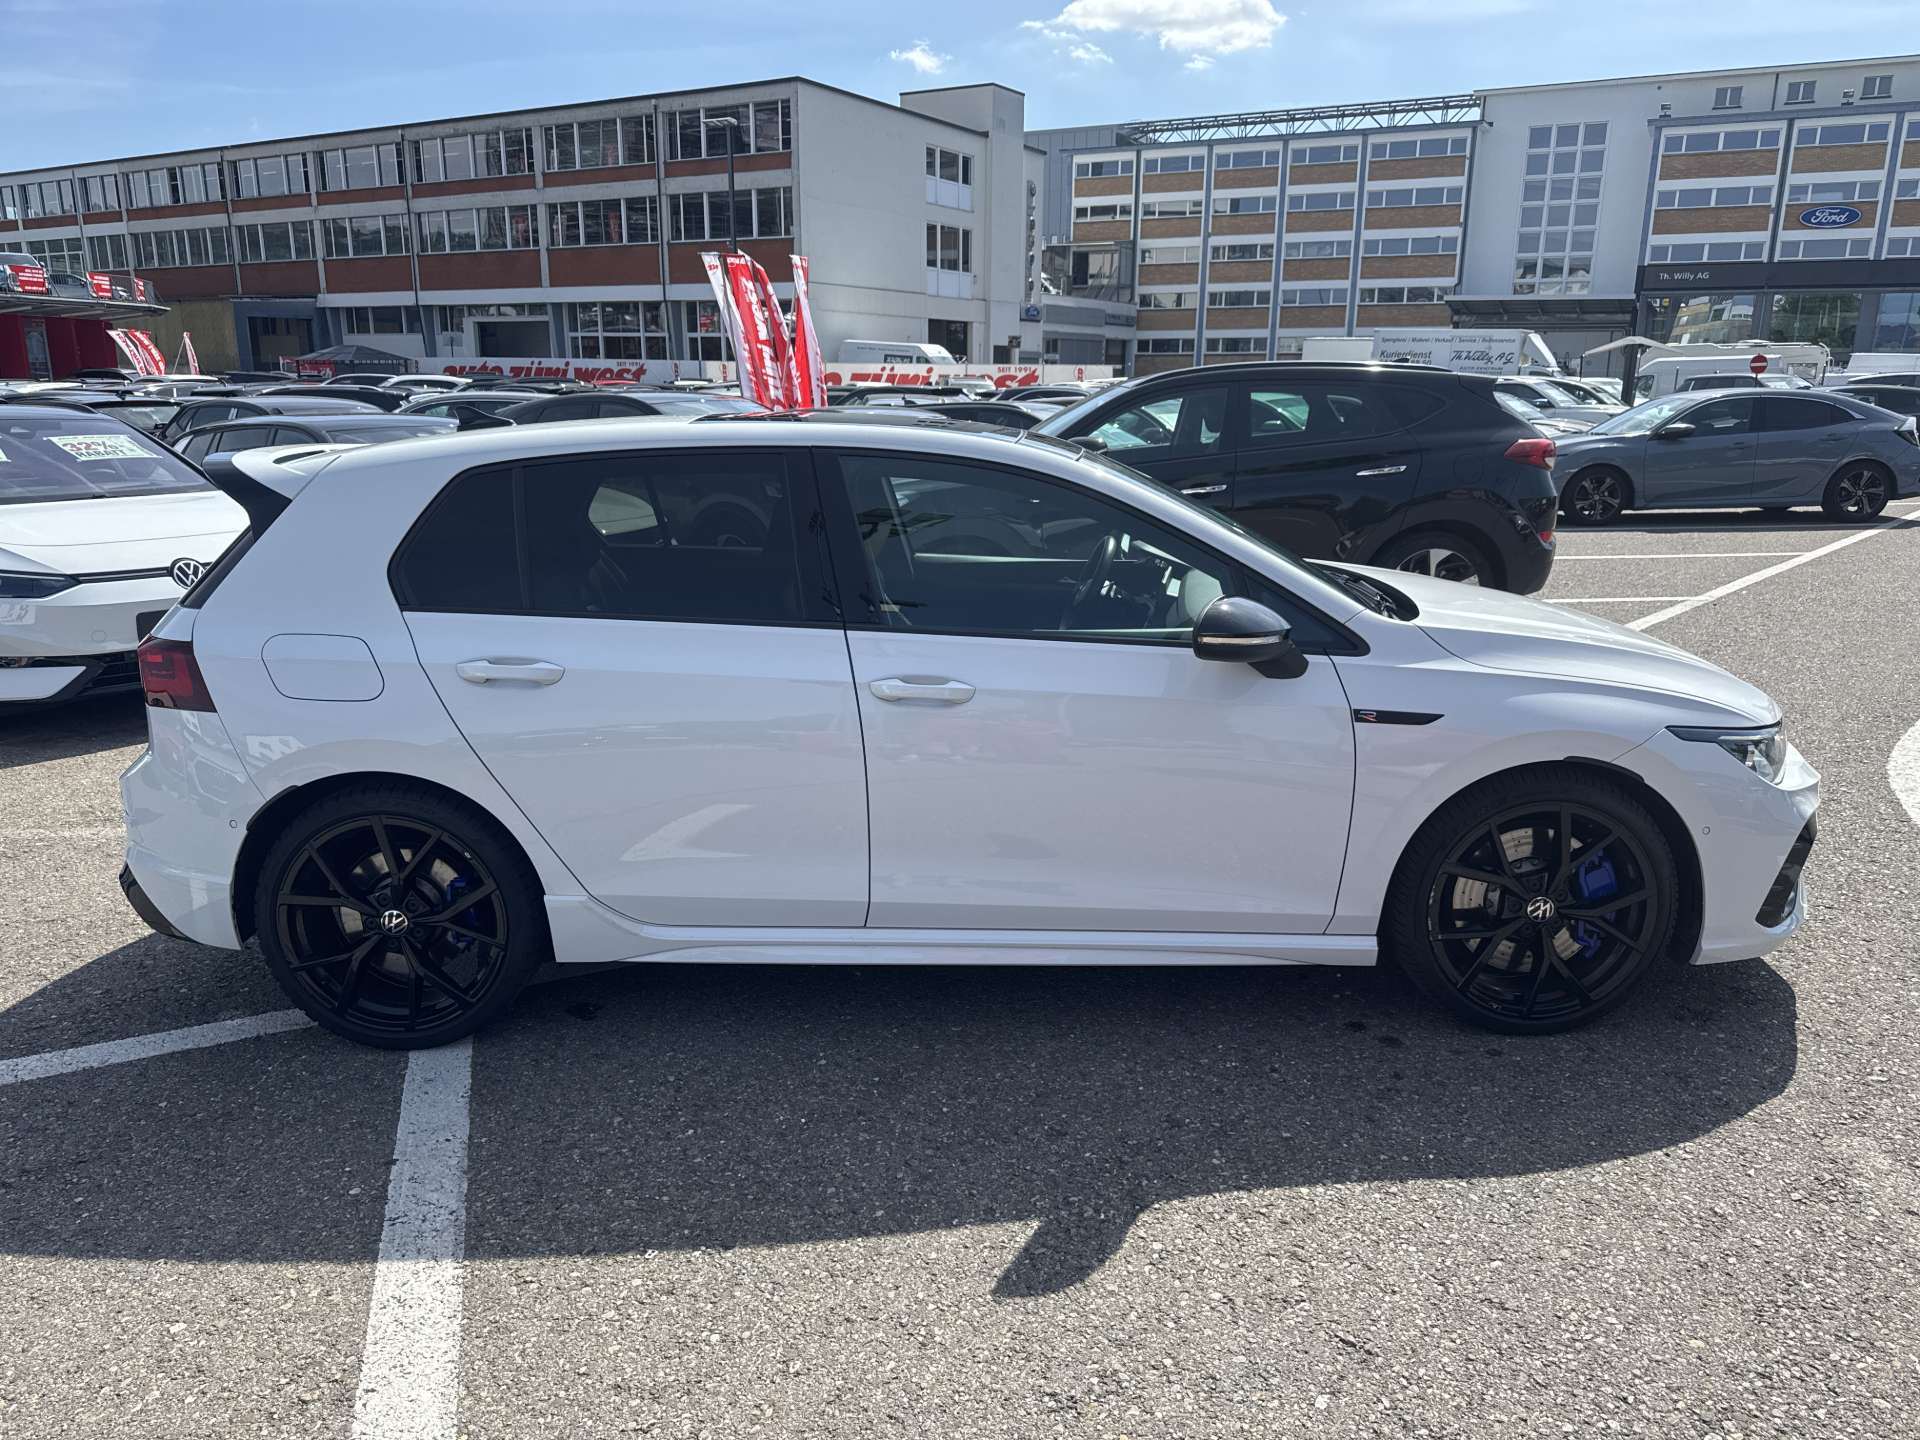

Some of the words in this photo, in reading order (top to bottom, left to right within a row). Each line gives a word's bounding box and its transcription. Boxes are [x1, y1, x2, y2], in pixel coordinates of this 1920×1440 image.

[1810, 209, 1850, 223] Ford
[1673, 272, 1694, 280] Willy
[1379, 350, 1432, 359] Kurierdienst
[62, 440, 120, 452] 32%
[74, 449, 127, 458] RABATT
